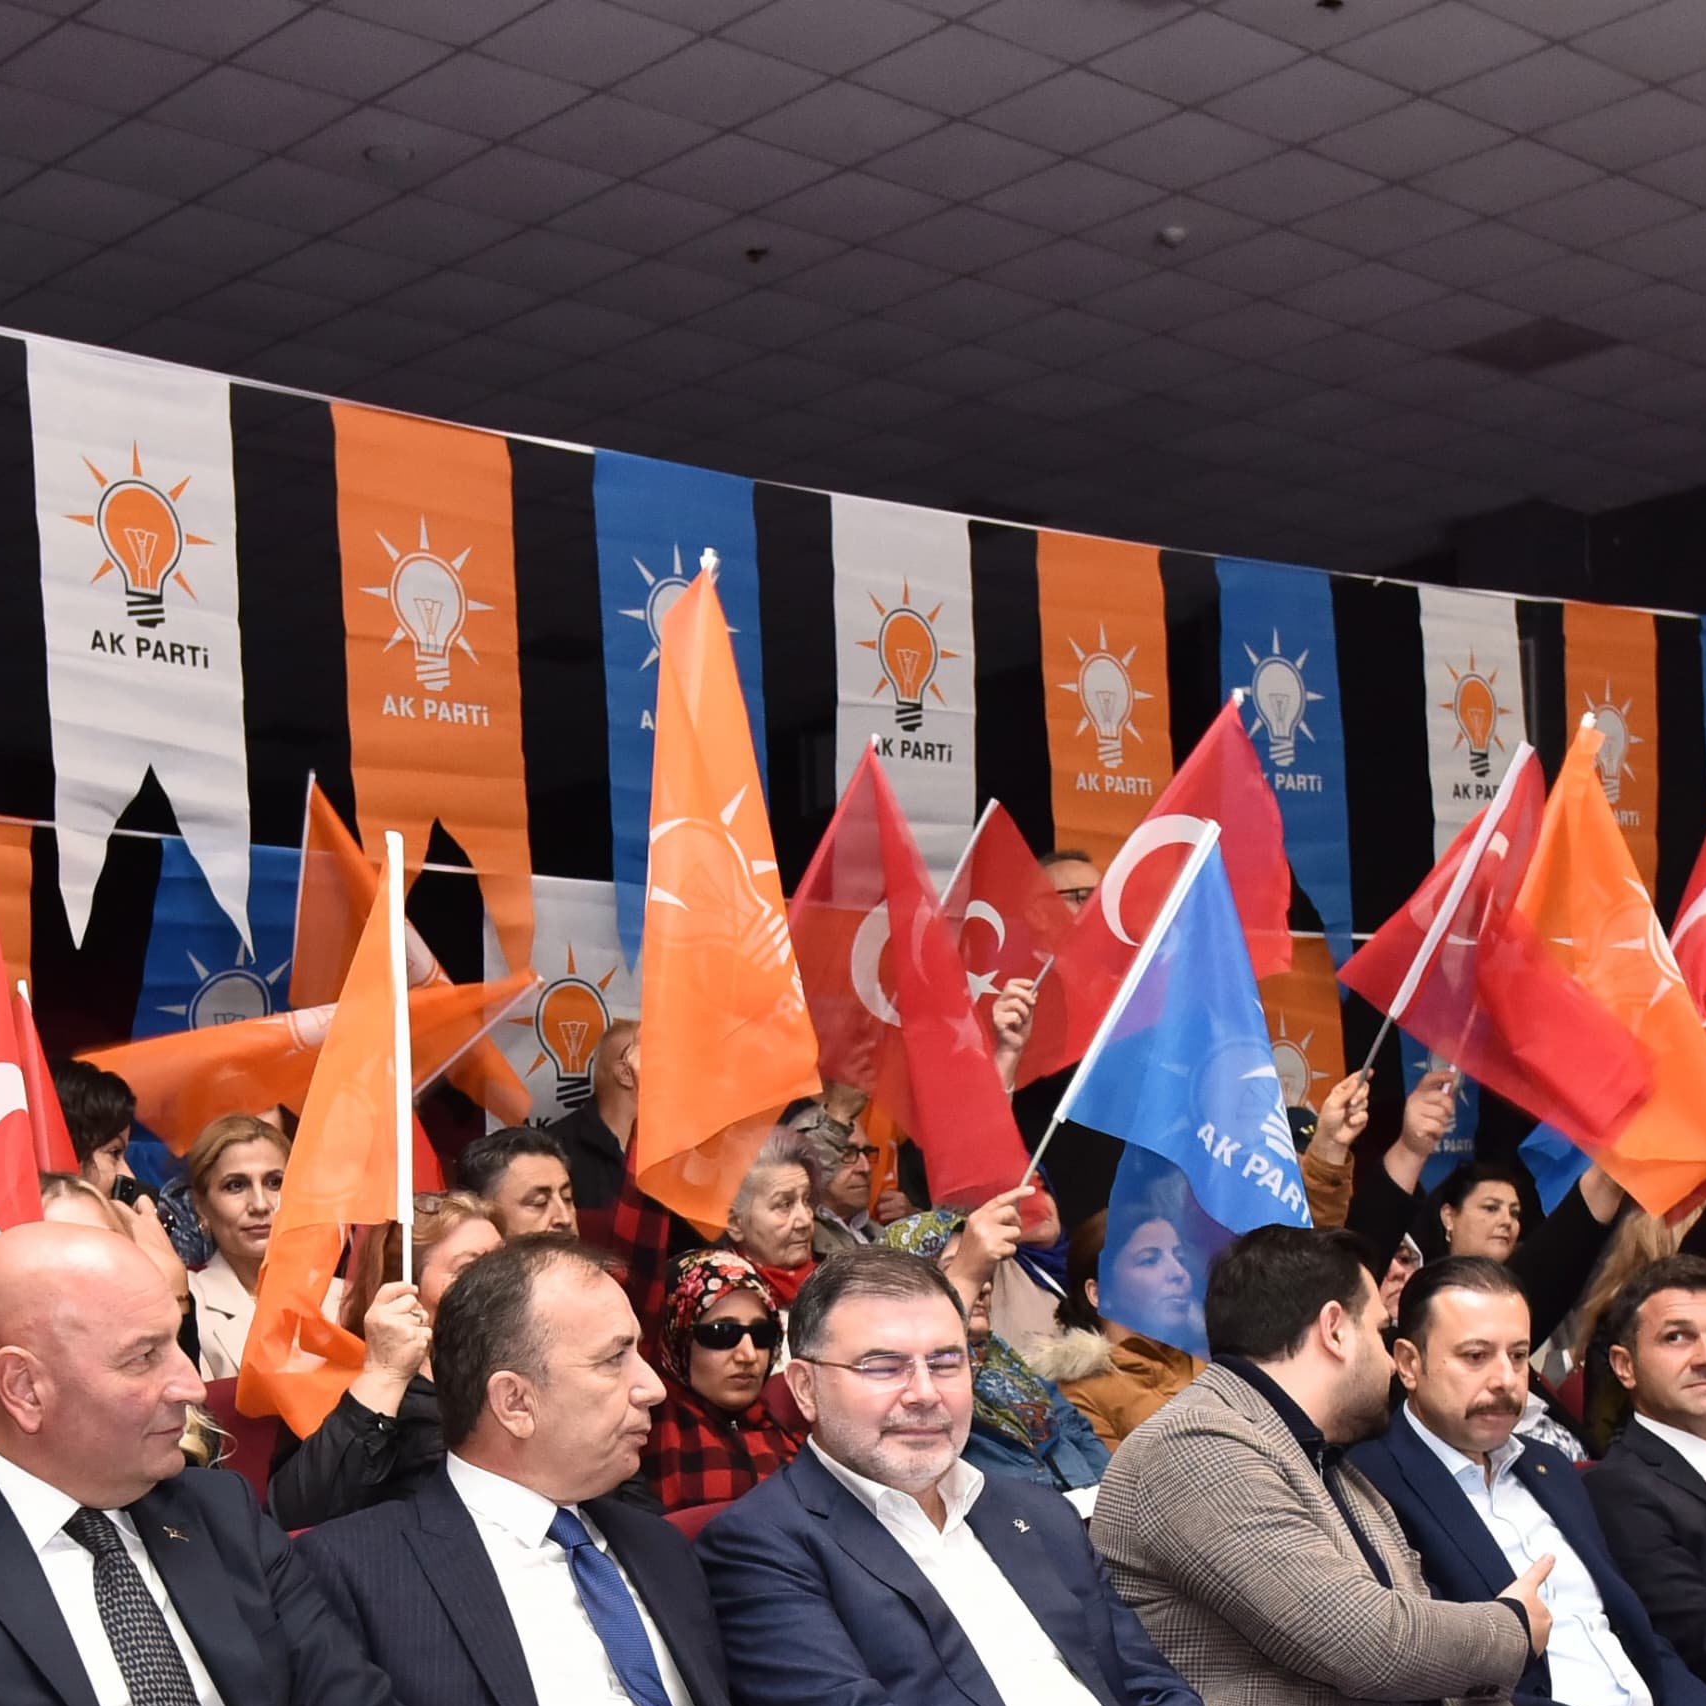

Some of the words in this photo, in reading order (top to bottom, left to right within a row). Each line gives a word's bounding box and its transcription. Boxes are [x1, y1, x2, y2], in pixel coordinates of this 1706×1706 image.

[91, 629, 126, 656] AK
[382, 694, 416, 719] AK
[1076, 772, 1100, 792] AK
[1452, 783, 1471, 800] AK
[1196, 1121, 1242, 1169] AK
